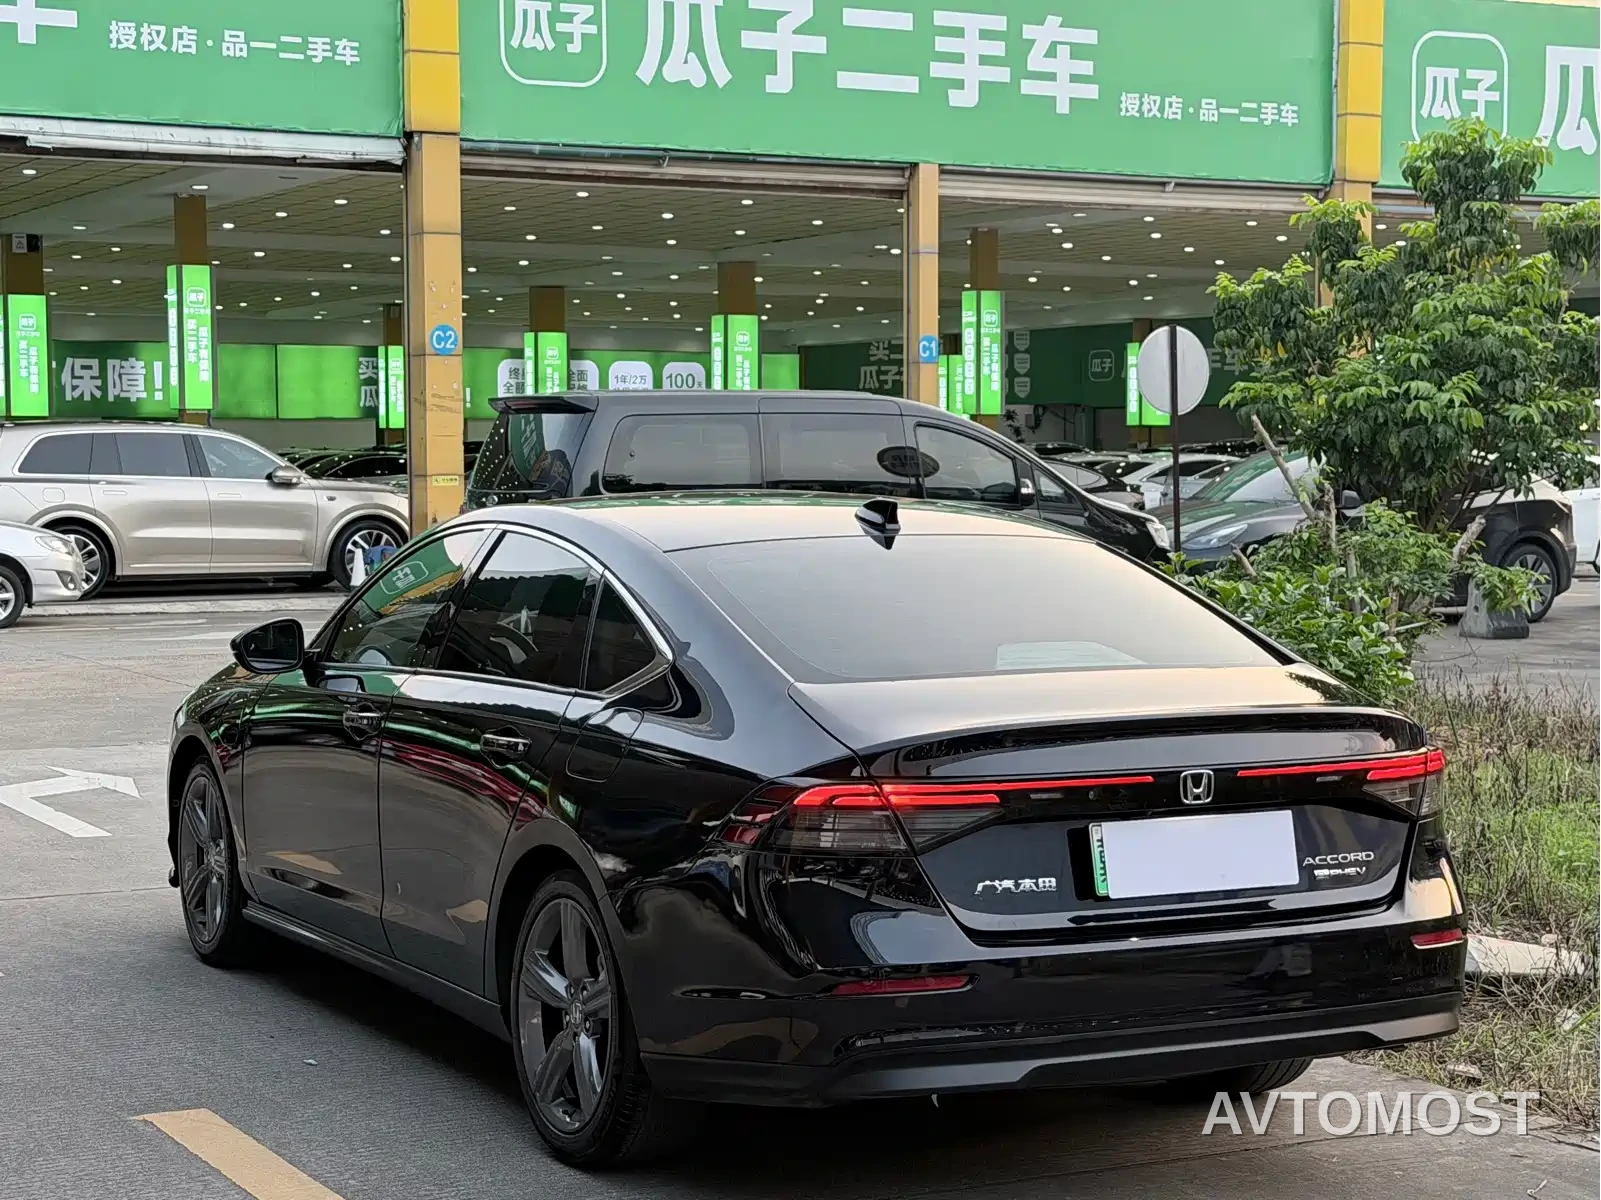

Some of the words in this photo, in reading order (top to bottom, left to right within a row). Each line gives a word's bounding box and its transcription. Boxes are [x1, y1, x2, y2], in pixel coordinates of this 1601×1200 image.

[510, 0, 598, 53] 瓜子
[635, 0, 1099, 115] 瓜子二手车
[1420, 66, 1500, 121] 瓜子
[432, 331, 456, 349] C2
[919, 341, 936, 358] C1
[1091, 358, 1113, 372] 瓜子
[859, 365, 903, 390] 瓜子
[1302, 851, 1375, 867] ACCORD
